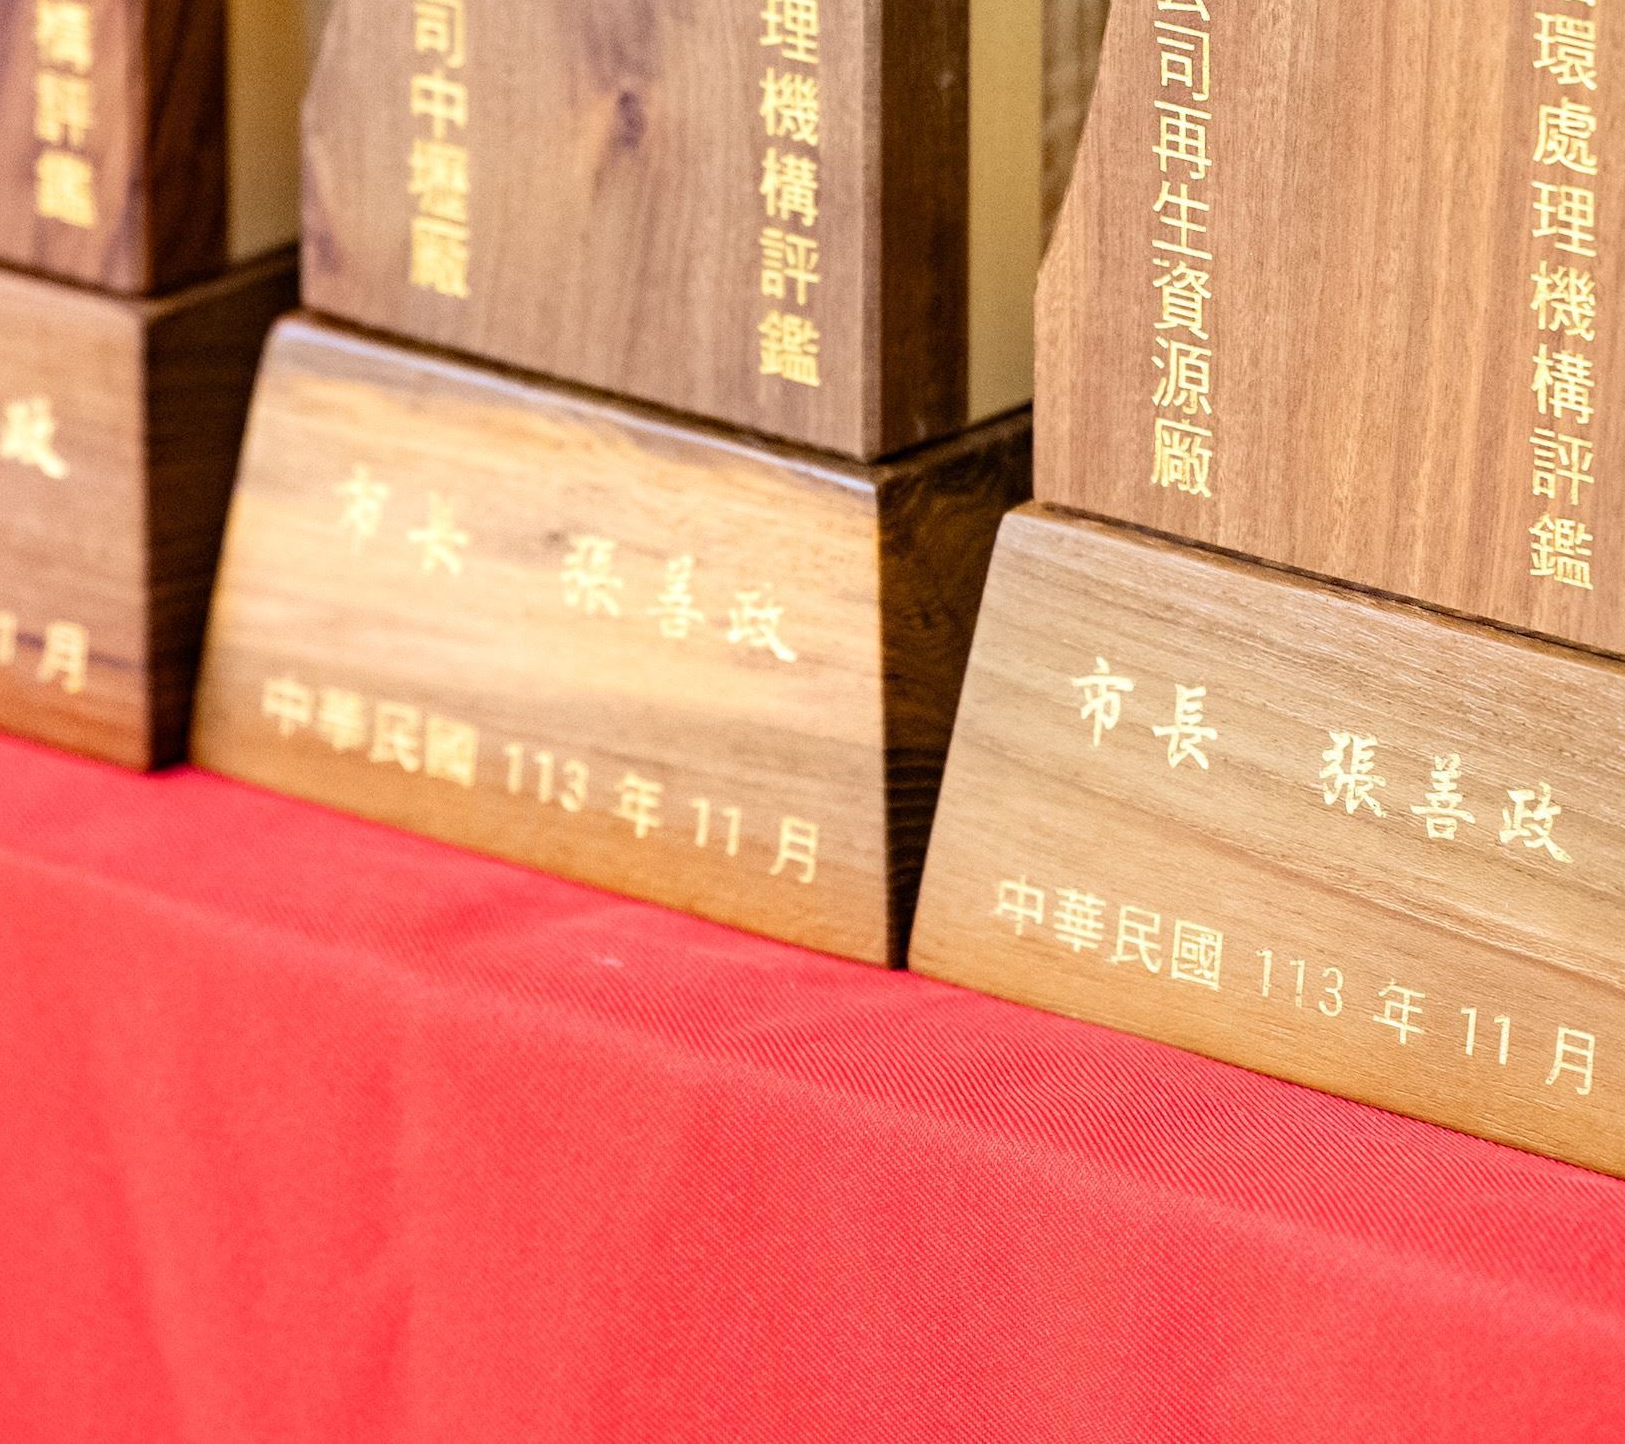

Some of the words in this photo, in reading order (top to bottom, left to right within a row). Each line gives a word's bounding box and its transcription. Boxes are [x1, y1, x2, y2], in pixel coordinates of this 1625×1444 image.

[505, 742, 589, 813] 113
[616, 772, 662, 839] 年
[690, 796, 742, 857] 11
[770, 815, 818, 884] 月
[1068, 656, 1219, 770] 市長
[1317, 729, 1574, 865] 張善政
[994, 875, 1224, 992] 中華民國
[1256, 949, 1345, 1020] 113
[1371, 980, 1425, 1046] 年
[1461, 1007, 1512, 1067] 11
[1546, 1025, 1596, 1097] 月
